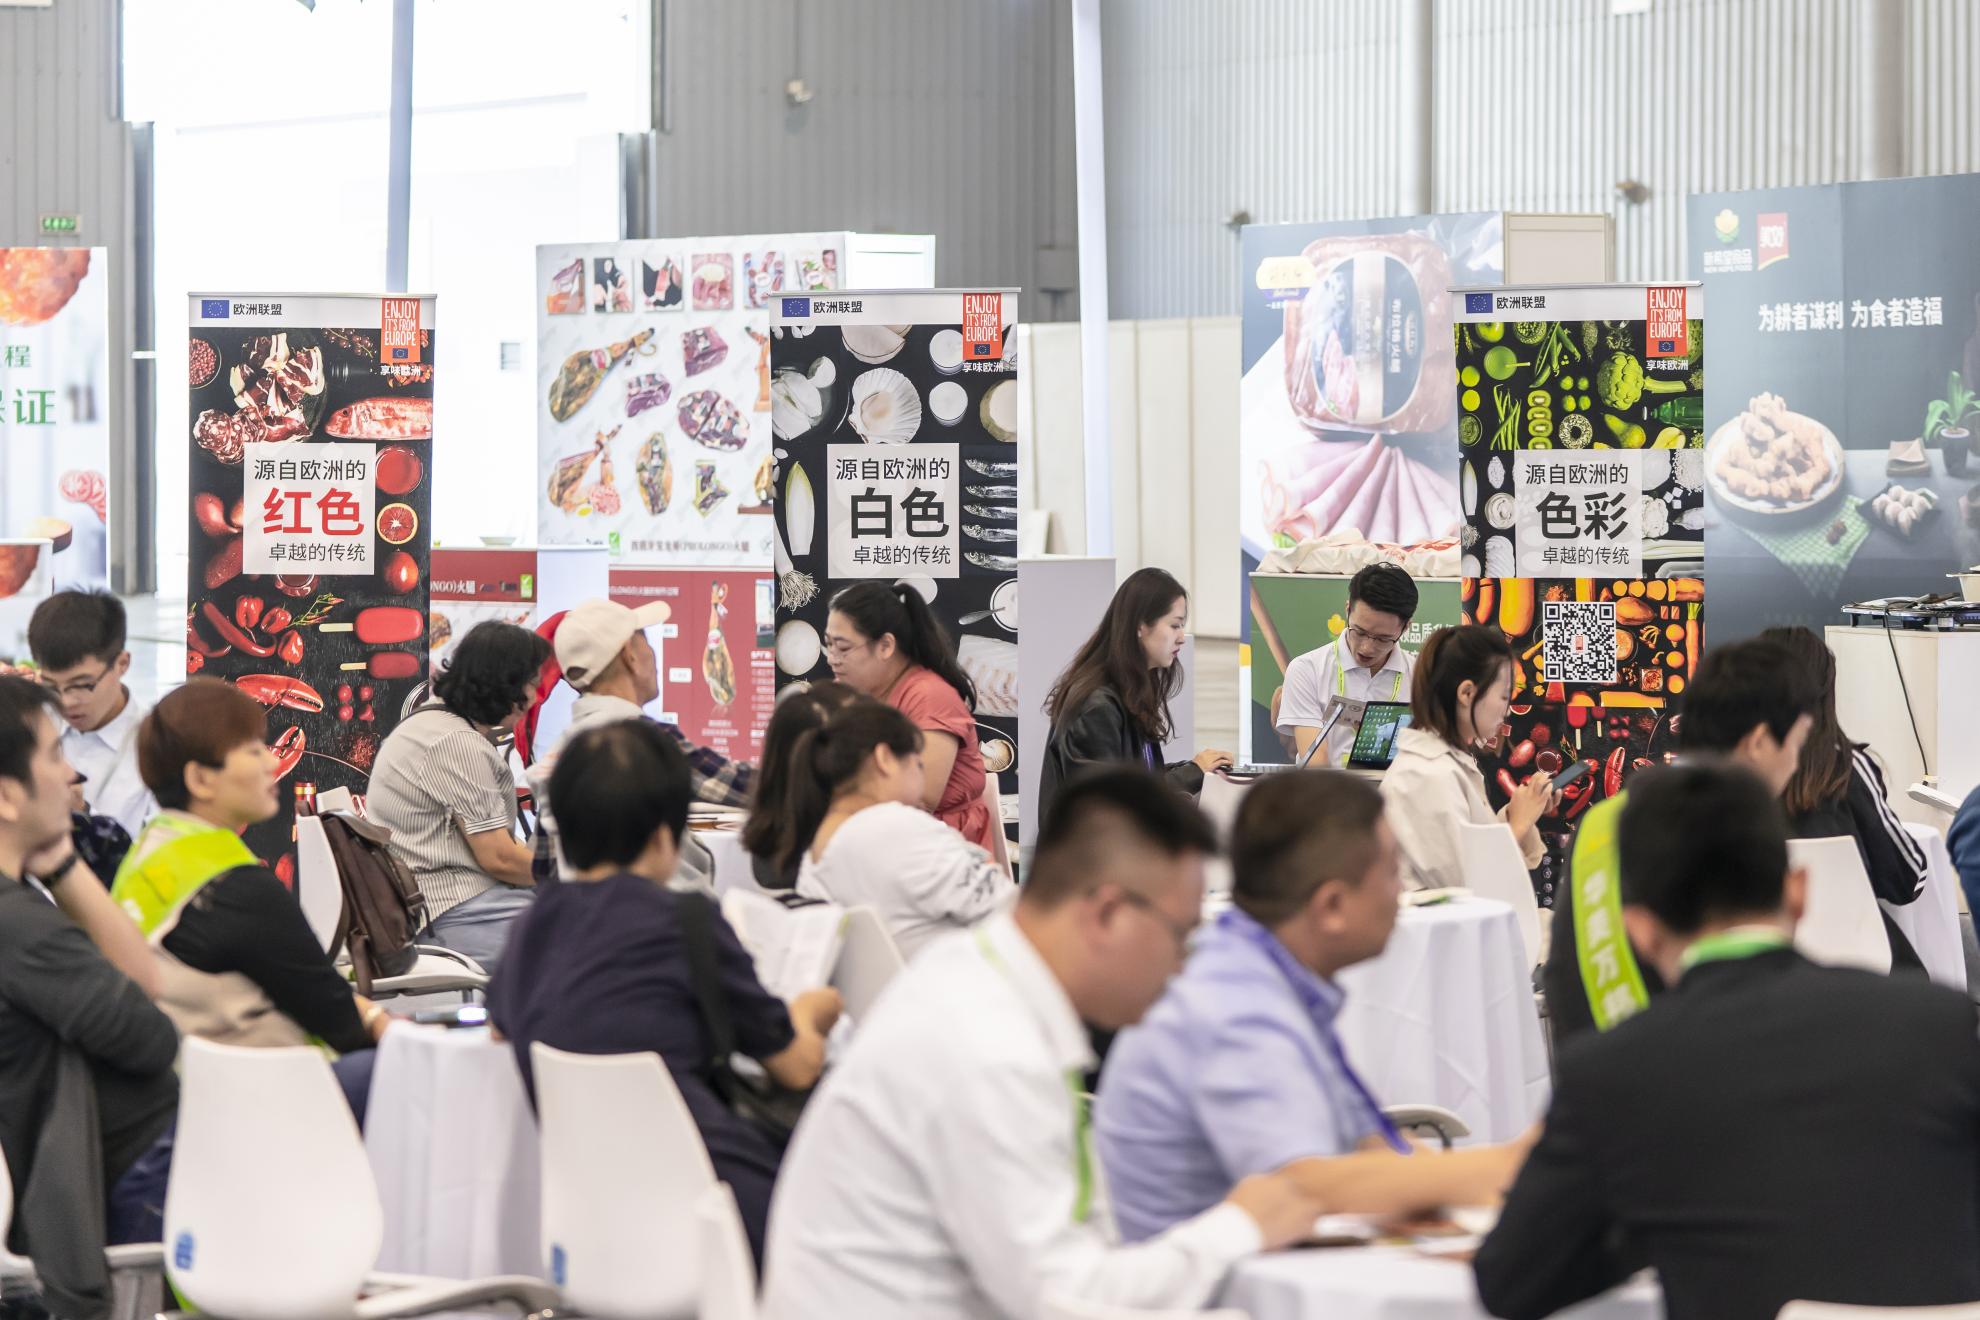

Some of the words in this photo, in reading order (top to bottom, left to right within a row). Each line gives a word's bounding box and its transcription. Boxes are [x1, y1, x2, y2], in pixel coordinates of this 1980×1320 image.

[813, 300, 863, 314] 欧洲联盟
[965, 295, 999, 314] ENJOY
[1496, 296, 1546, 309] 欧洲联盟
[1649, 289, 1684, 309] ENJOY
[233, 303, 282, 316] 欧洲联盟
[384, 300, 418, 319] ENJOY
[1665, 308, 1682, 321] FROM
[1758, 301, 1844, 332] 为耕者谋利
[1851, 296, 1943, 328] 为食者造福
[399, 319, 416, 331] FROM
[980, 314, 998, 326] FROM
[384, 332, 417, 346] EUROPE
[966, 327, 998, 342] EUROPE
[1650, 322, 1683, 338] EUROPE
[962, 362, 1004, 373] 享味欧洲
[1646, 360, 1688, 371] 享味欧洲
[0, 388, 56, 424] 证
[254, 459, 366, 480] 源自欧洲的
[836, 458, 950, 480] 源自欧洲的
[1525, 463, 1629, 484] 源自欧洲的
[263, 487, 365, 536] 红色
[850, 486, 950, 539] 白色
[1536, 491, 1629, 540] 色彩
[268, 543, 366, 562] 卓越的传统
[852, 545, 951, 564] 卓越的传统
[1542, 546, 1630, 565] 卓越的传统
